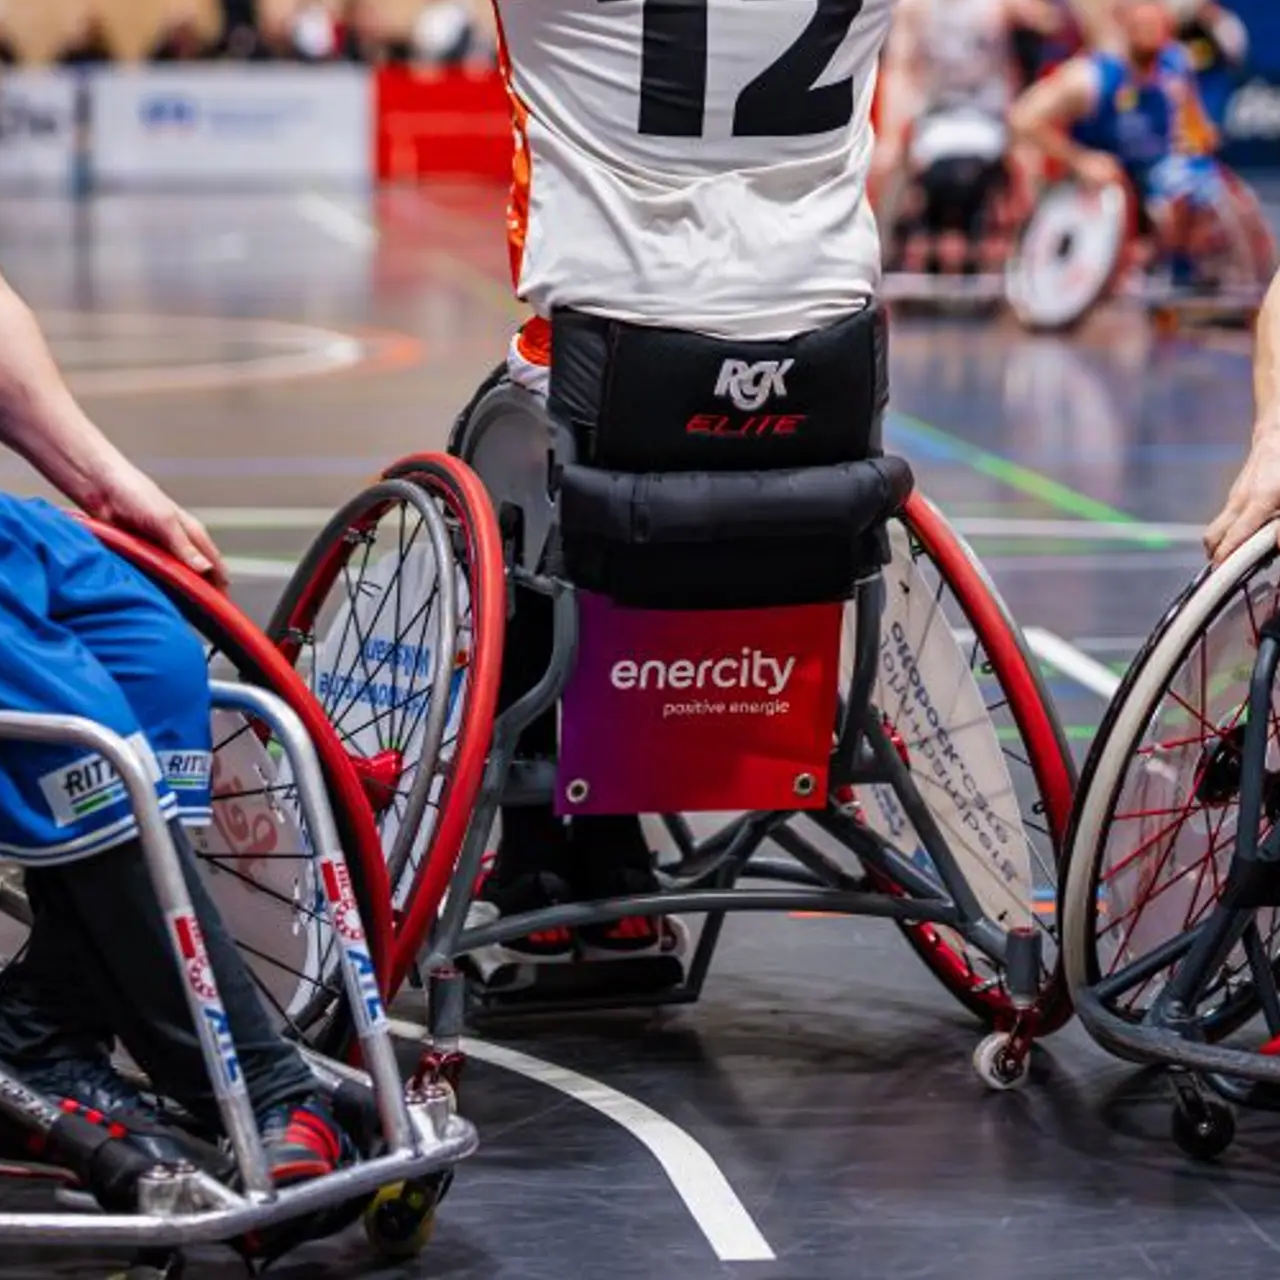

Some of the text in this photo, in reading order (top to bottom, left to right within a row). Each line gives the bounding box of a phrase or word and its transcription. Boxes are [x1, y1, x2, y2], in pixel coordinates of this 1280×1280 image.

[714, 358, 795, 411] RGK
[685, 414, 806, 437] ELITE
[610, 647, 797, 695] enercity
[663, 699, 790, 718] positive energie
